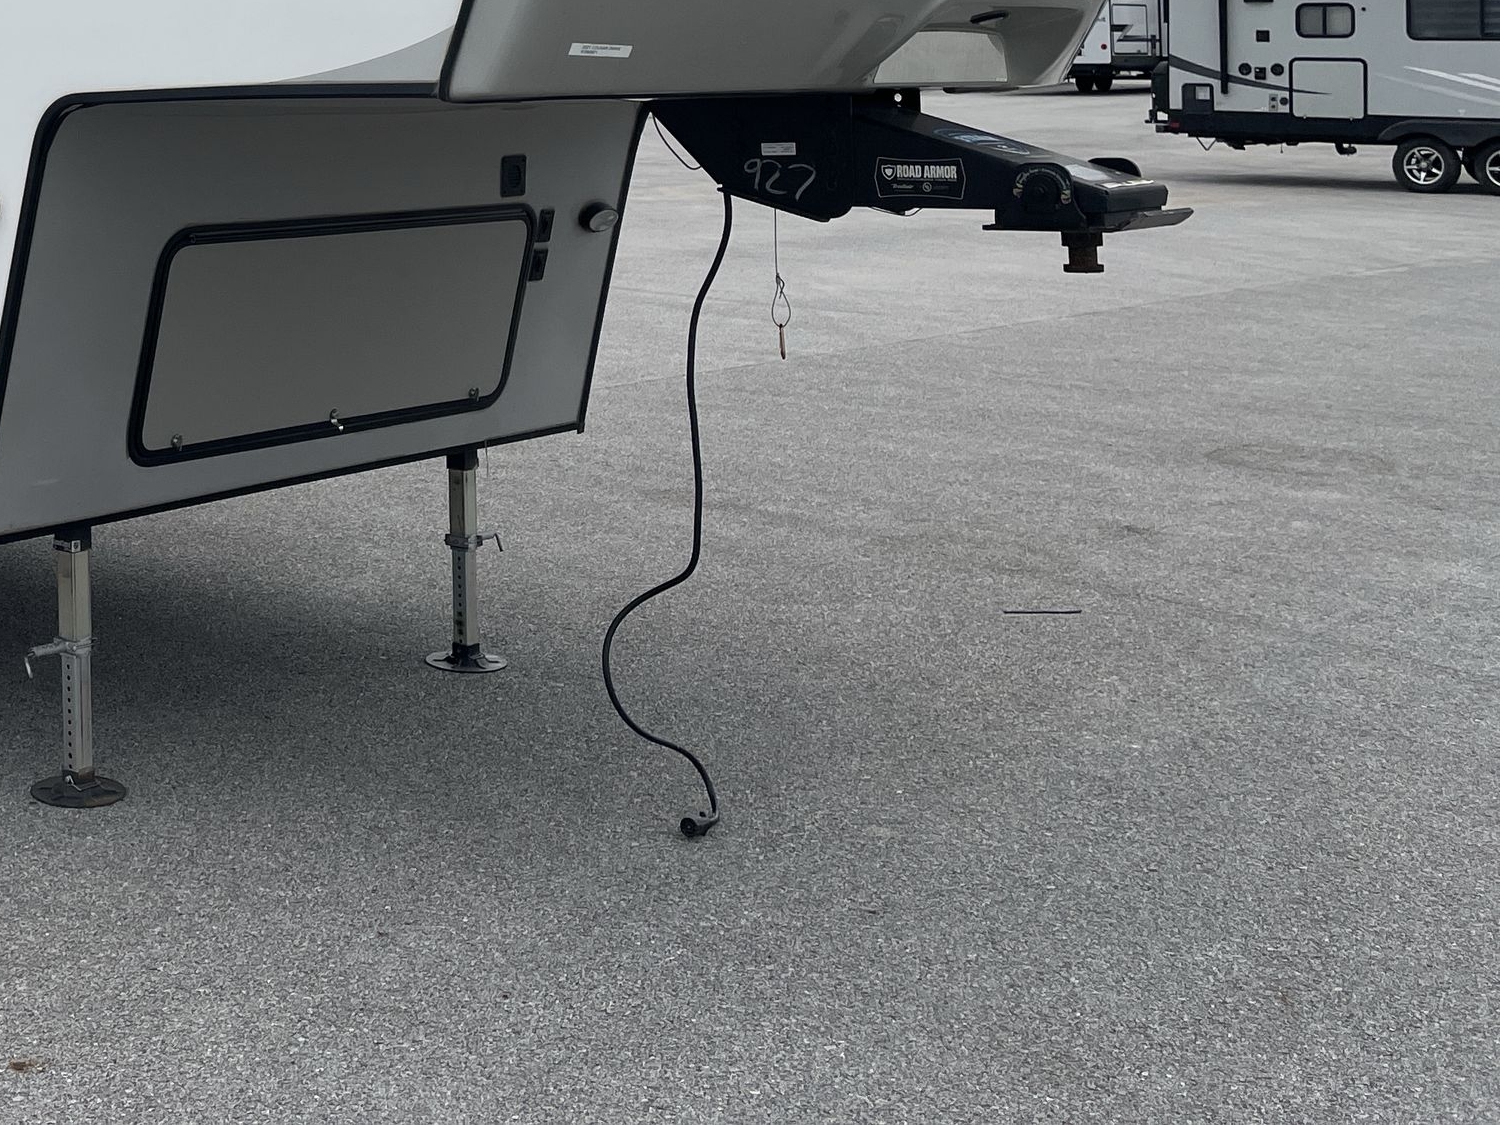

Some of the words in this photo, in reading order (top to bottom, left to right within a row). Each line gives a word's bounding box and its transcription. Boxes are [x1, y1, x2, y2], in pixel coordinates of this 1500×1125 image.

[743, 158, 816, 202] 927
[896, 164, 922, 179] ROAD
[923, 165, 958, 179] ARMOR
